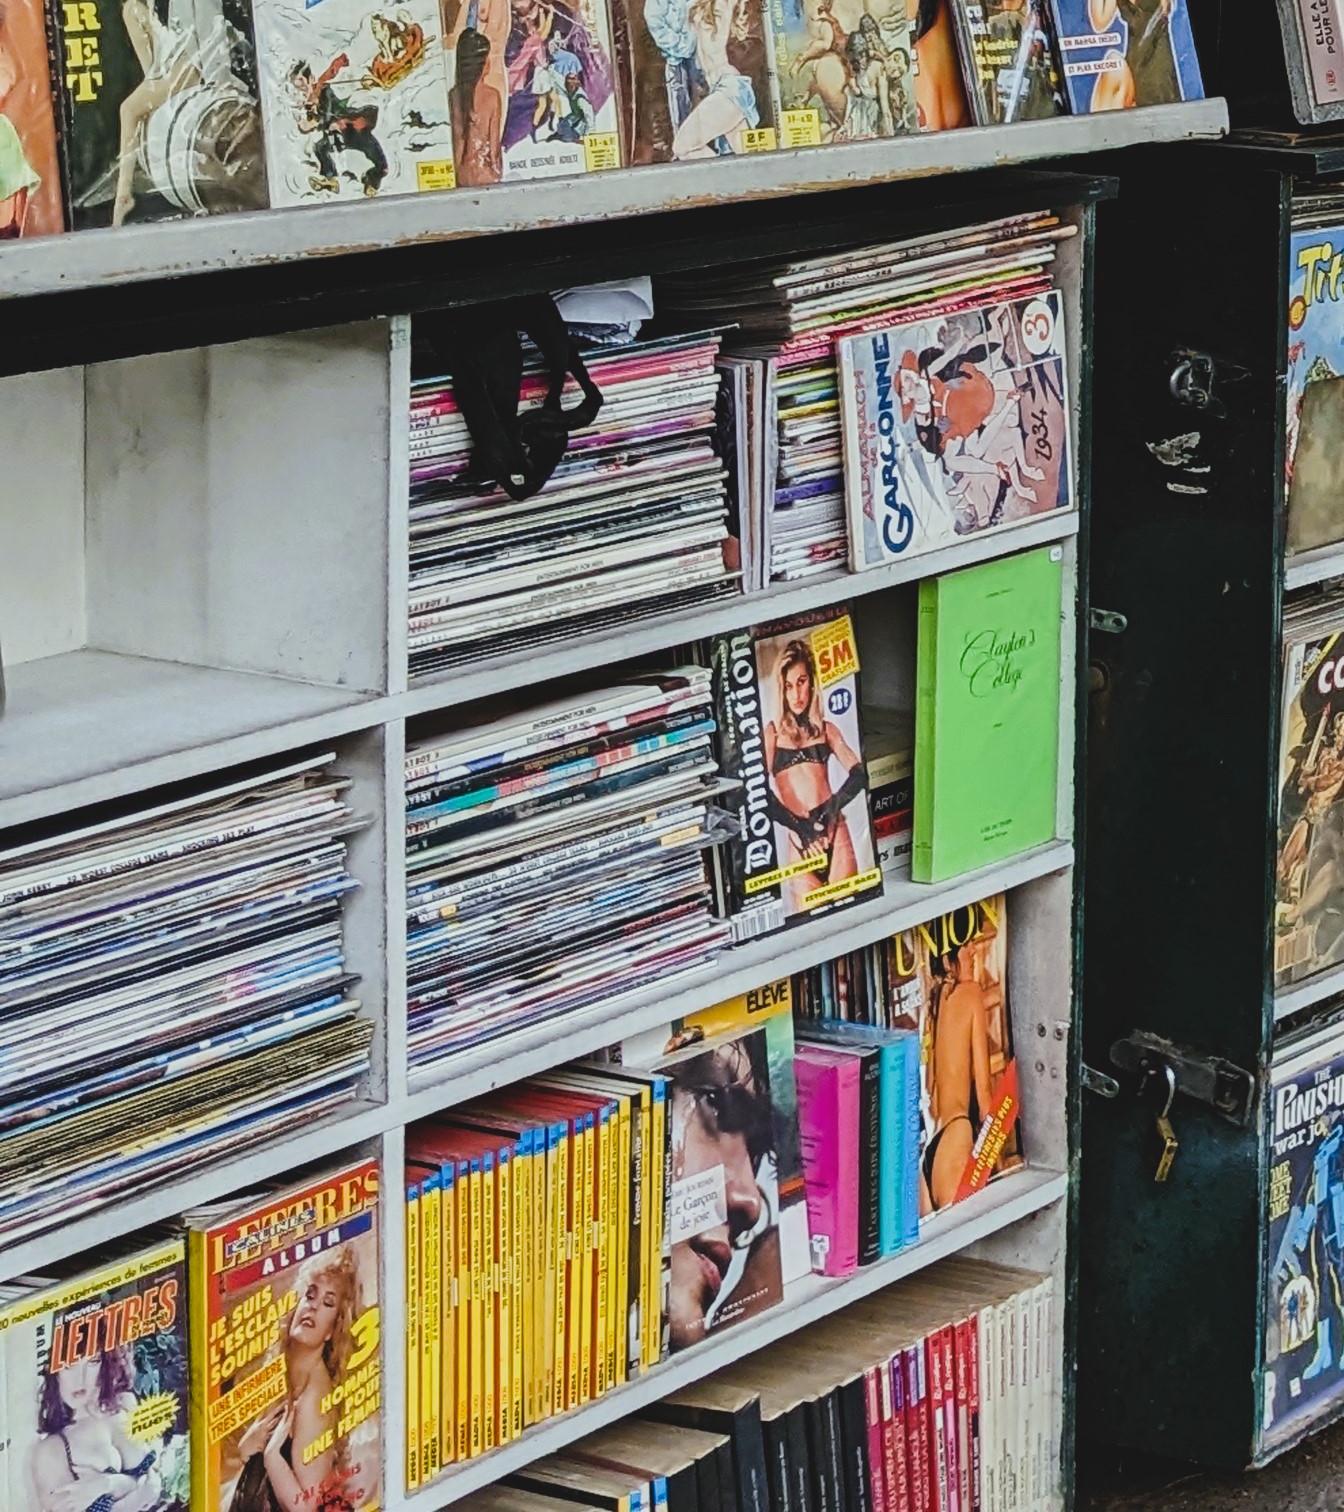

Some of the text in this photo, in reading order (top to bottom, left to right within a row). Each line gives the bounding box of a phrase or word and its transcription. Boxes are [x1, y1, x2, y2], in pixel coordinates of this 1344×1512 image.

[870, 331, 915, 555] GARÇONNE
[1033, 406, 1054, 463] 1934
[817, 639, 853, 672] SM
[731, 632, 774, 875] Domination
[874, 791, 911, 811] ART OF
[894, 895, 1001, 977] UNION
[1314, 1067, 1333, 1085] THE
[1274, 1126, 1304, 1156] war
[211, 1169, 381, 1276] LETTRES
[679, 1209, 711, 1231] de joie
[683, 1189, 719, 1214] Garçon
[262, 1227, 342, 1276] ALBUM
[12, 1252, 178, 1326] nouvelles expériences de femmes
[209, 1284, 273, 1343] JE SUIS
[50, 1278, 180, 1375] LETTRES
[210, 1289, 298, 1366] L'ESCLAVE
[347, 1305, 381, 1372] 3
[210, 1326, 282, 1388] SOUMIS
[131, 1410, 174, 1436] nues
[209, 1394, 231, 1419] UNE
[211, 1419, 237, 1444] TRES
[302, 1433, 334, 1466] UNE
